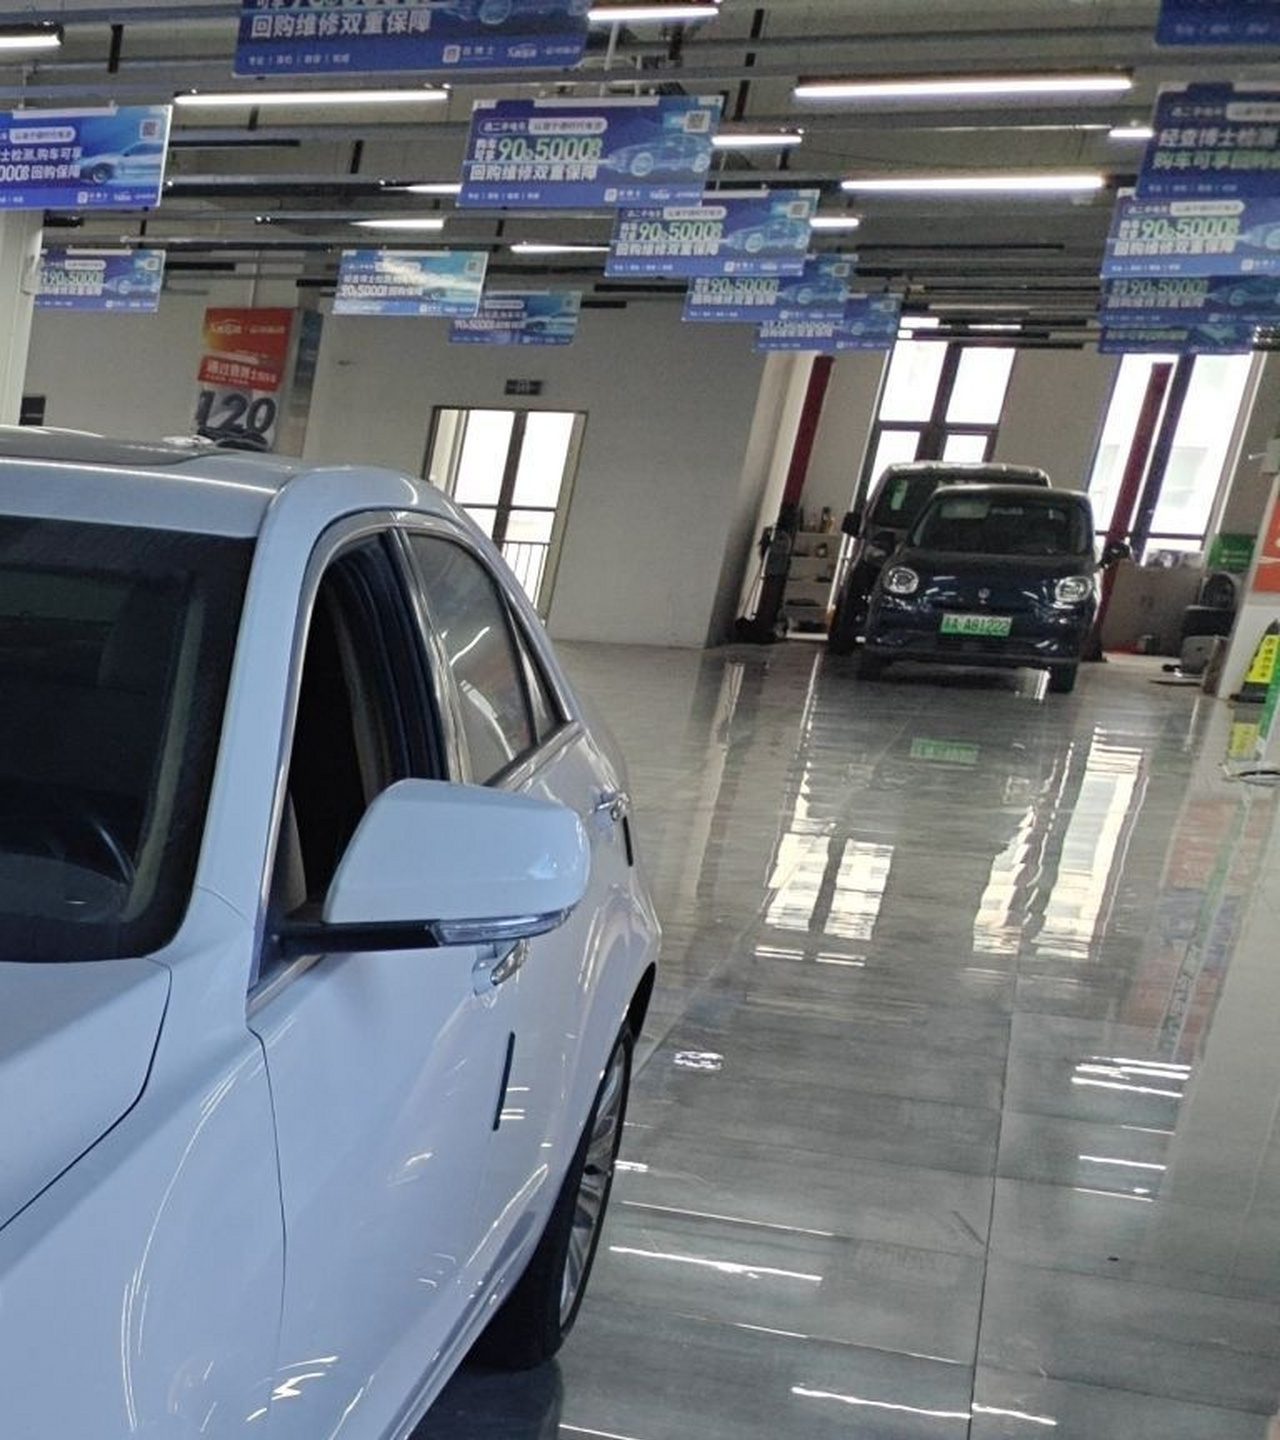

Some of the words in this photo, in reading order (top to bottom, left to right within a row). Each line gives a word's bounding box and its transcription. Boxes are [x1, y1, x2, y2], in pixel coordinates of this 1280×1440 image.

[251, 8, 432, 39] 回购维修双重保障
